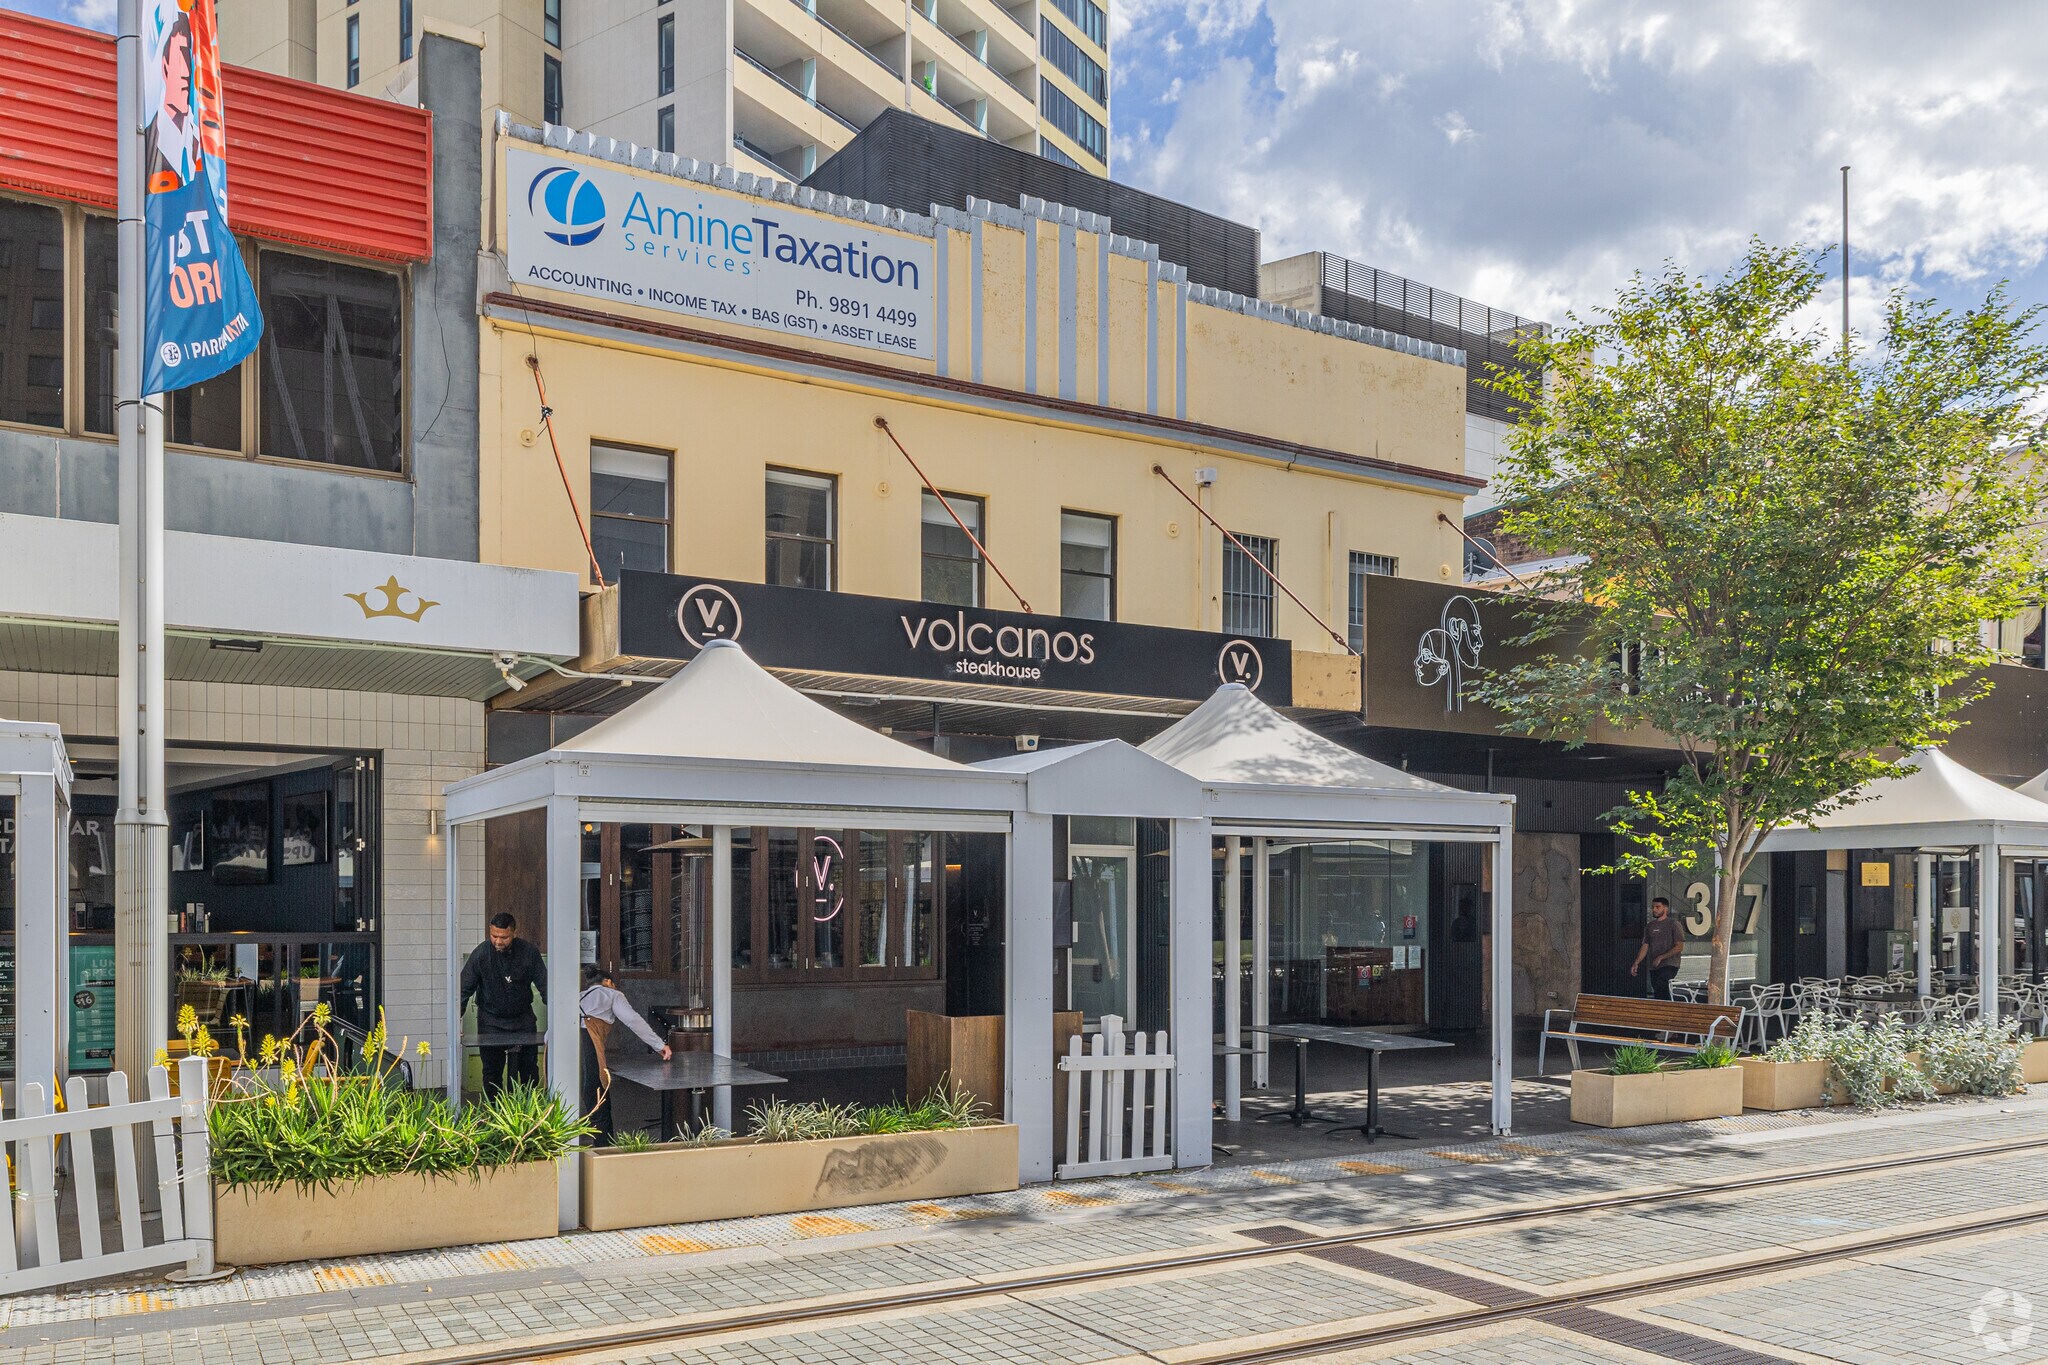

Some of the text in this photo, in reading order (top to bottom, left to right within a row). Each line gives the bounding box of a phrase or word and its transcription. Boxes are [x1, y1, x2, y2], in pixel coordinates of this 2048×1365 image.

[624, 233, 751, 275] Services
[528, 265, 917, 350] ACCOUNTING INCOME TAX BAS (GST) ASSET LEASE
[796, 289, 917, 328] Ph. 9891 4499
[900, 611, 1095, 664] volcanos
[956, 658, 1041, 680] steakhouse
